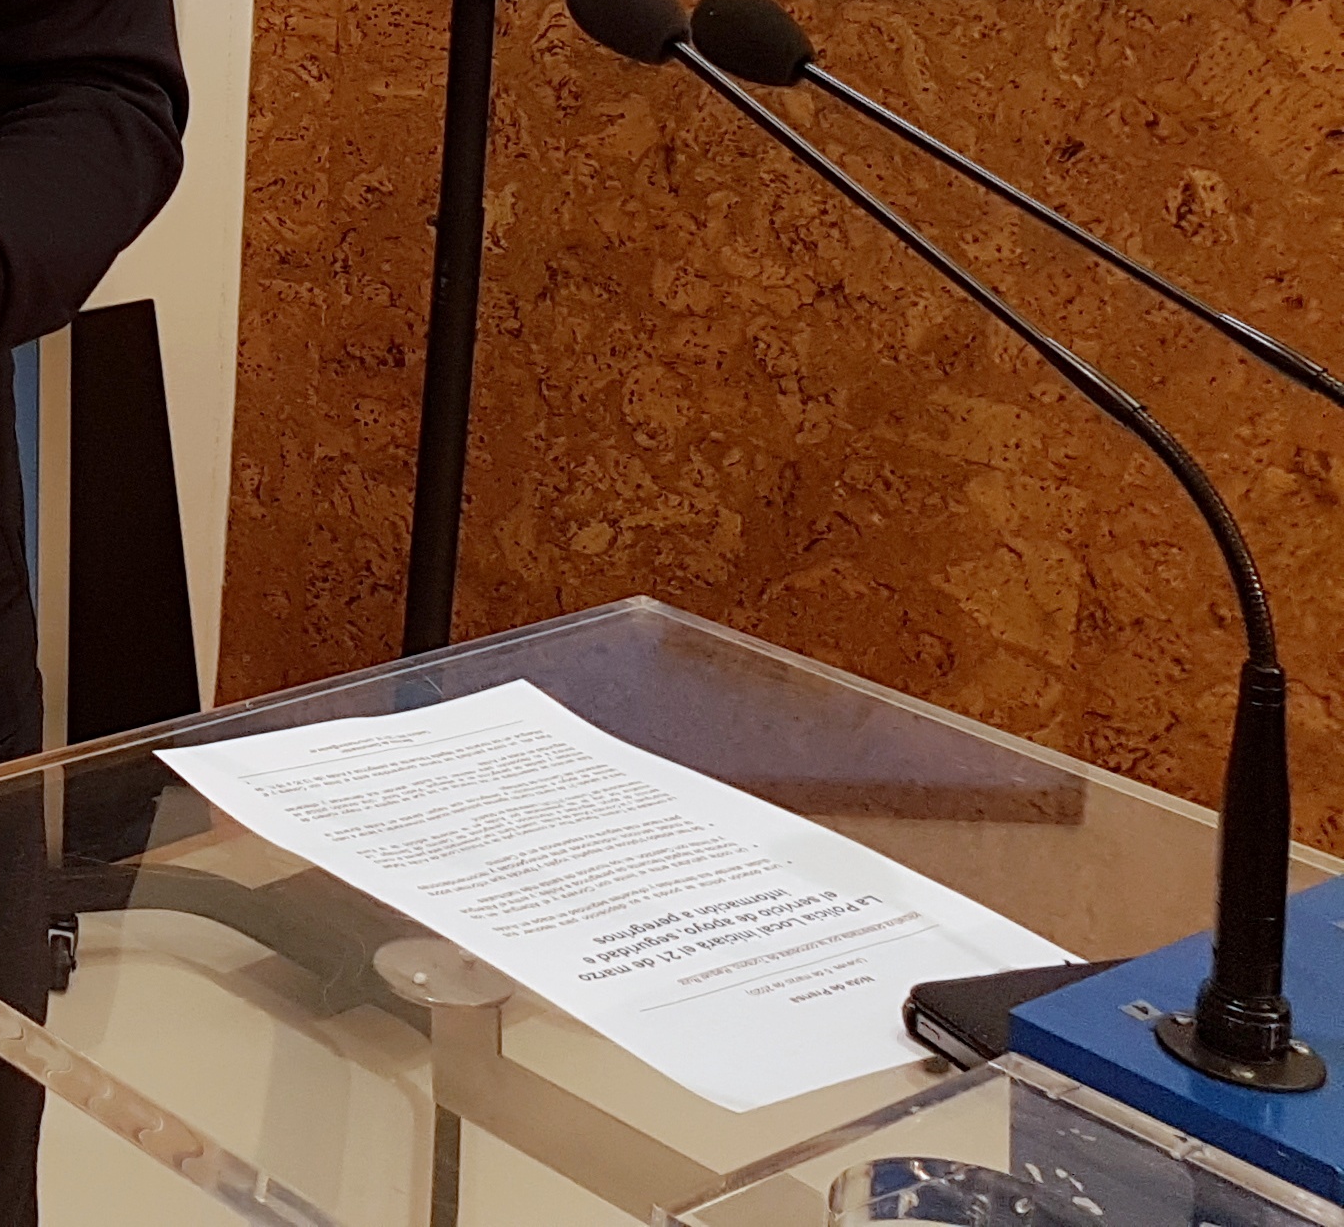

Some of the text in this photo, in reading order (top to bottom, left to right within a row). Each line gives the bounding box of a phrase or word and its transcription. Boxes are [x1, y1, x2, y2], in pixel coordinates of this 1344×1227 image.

[693, 889, 792, 915] información
[758, 896, 821, 916] servicio
[819, 891, 837, 901] el
[593, 913, 681, 944] peregrinos
[676, 918, 735, 935] apoyo,
[735, 913, 758, 922] de
[578, 895, 883, 981] La Policía Local iniciará el 21 de marzo
[596, 933, 680, 963] seguridad
